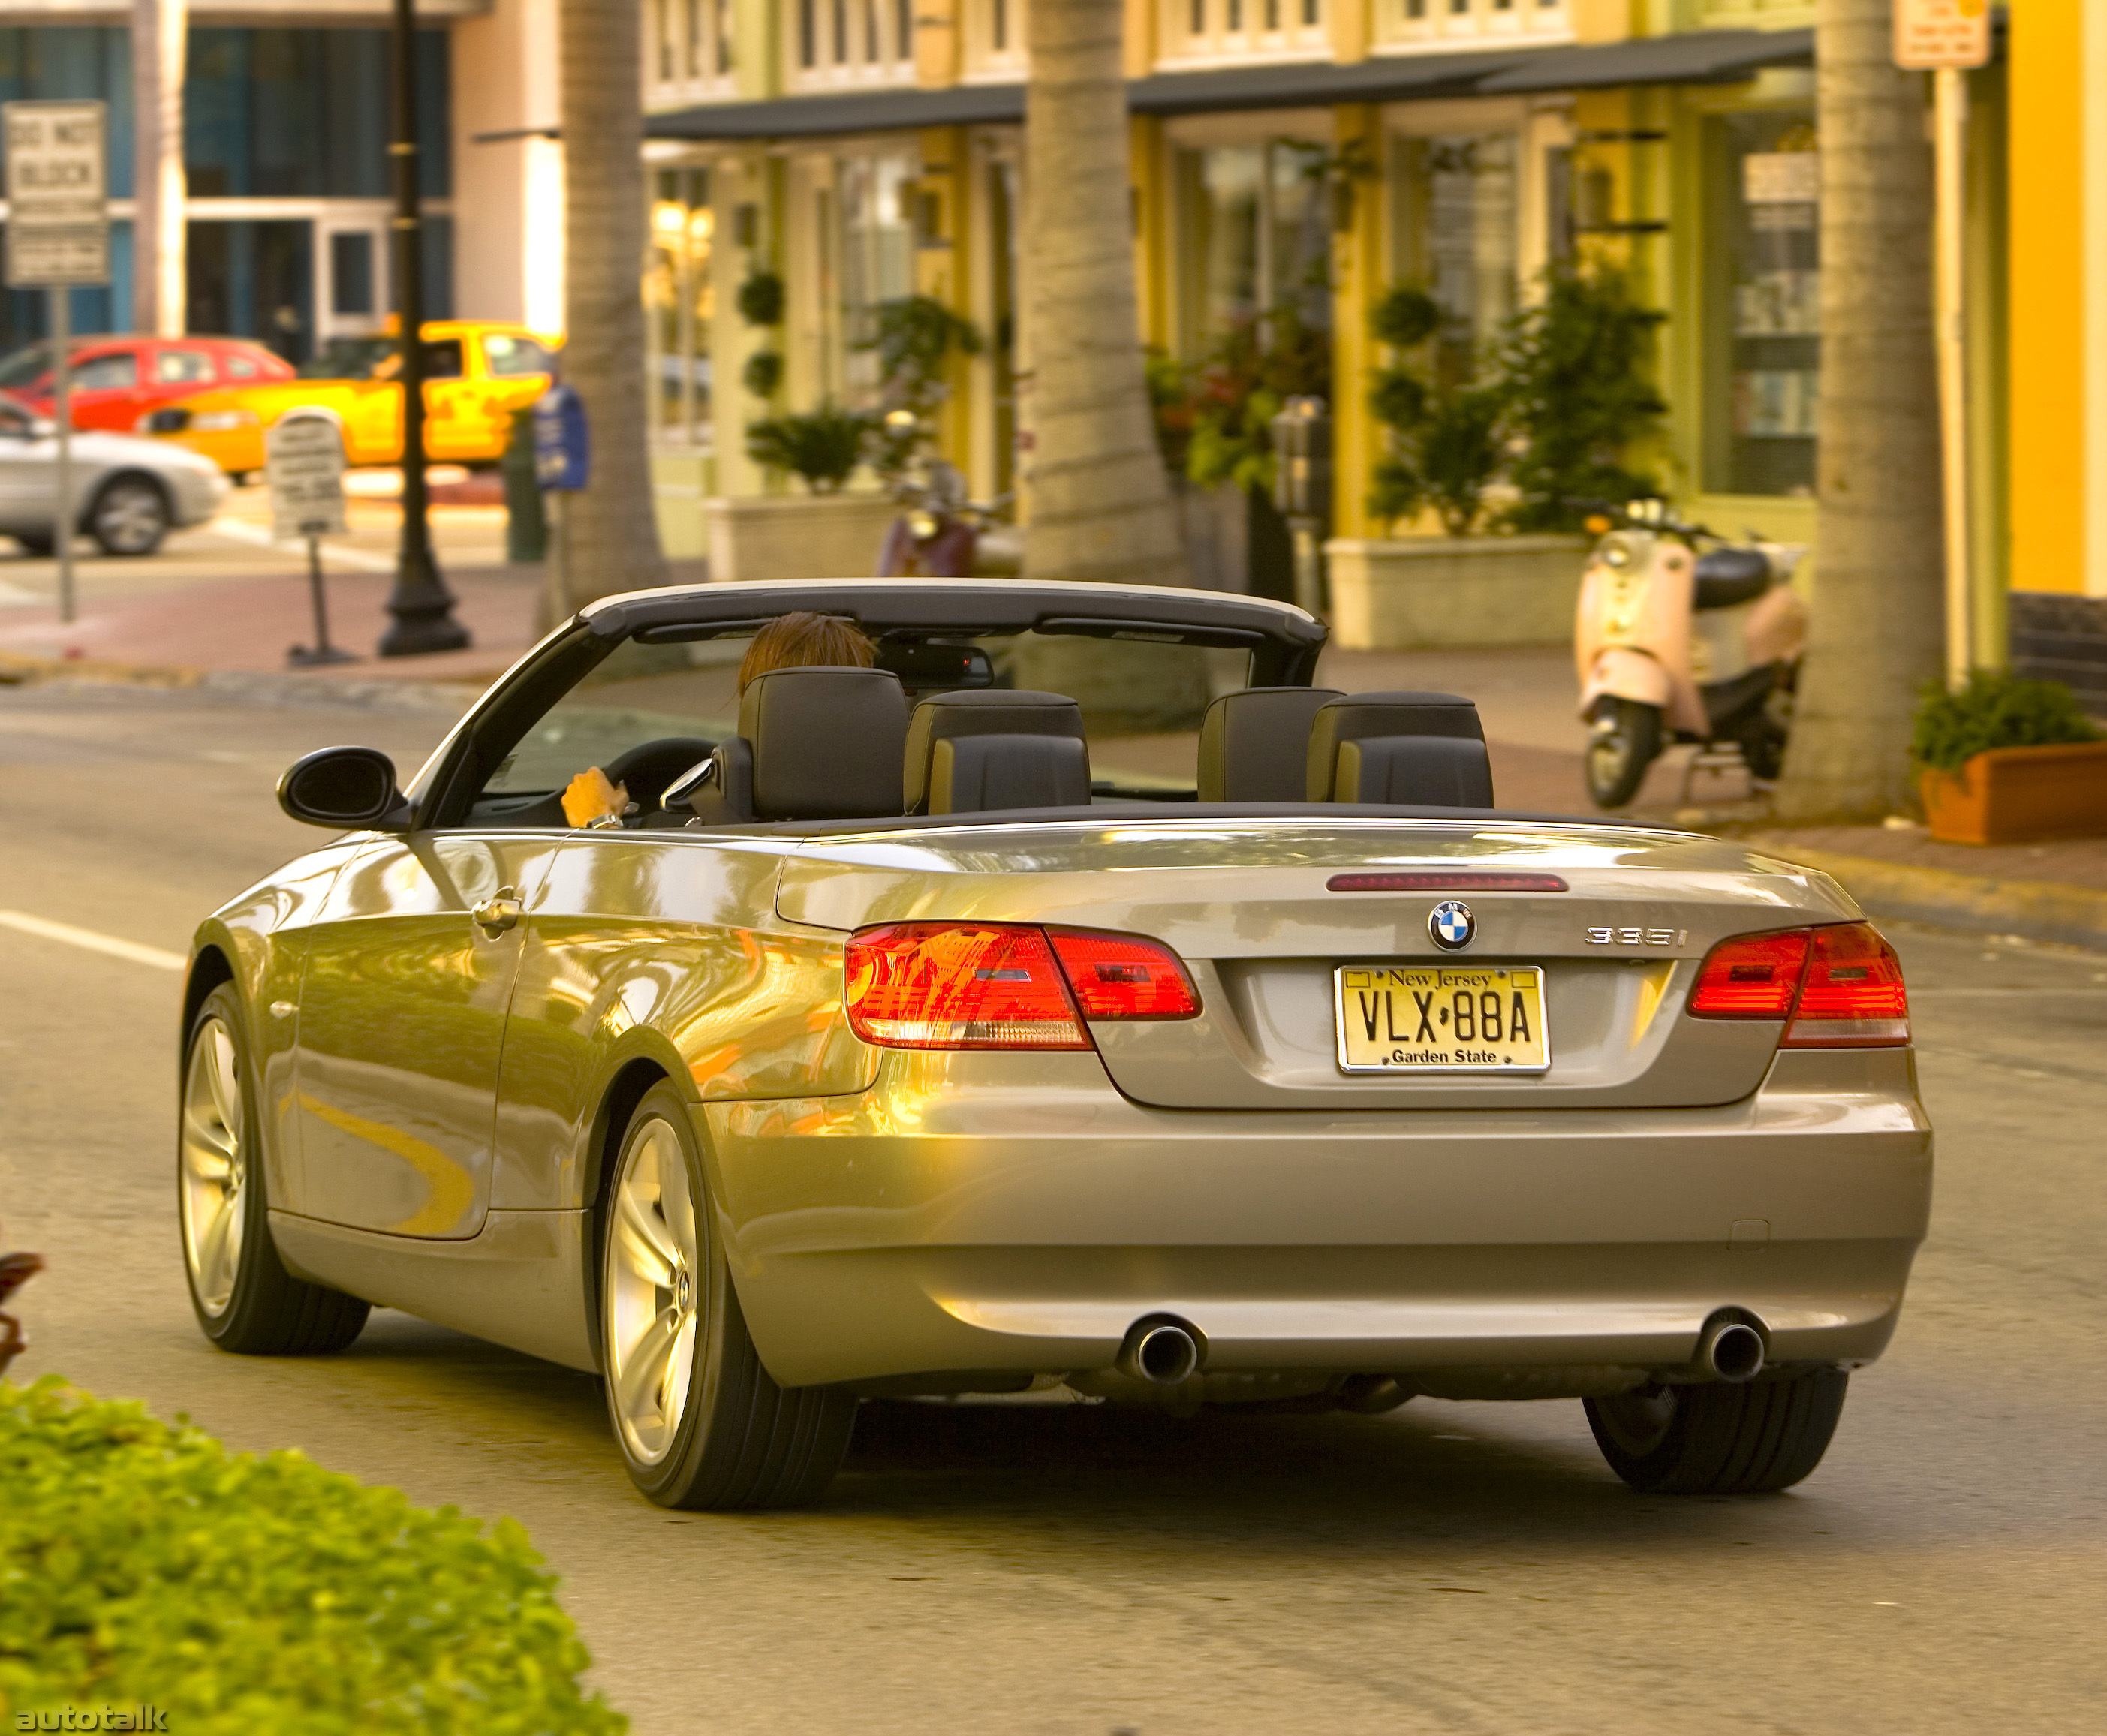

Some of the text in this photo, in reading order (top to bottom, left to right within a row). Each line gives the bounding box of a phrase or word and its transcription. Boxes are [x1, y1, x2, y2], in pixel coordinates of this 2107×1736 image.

[1434, 902, 1473, 919] BMW
[1585, 926, 1688, 946] 335i
[1387, 969, 1491, 991] New Jersey
[1392, 1049, 1497, 1064] Garden State
